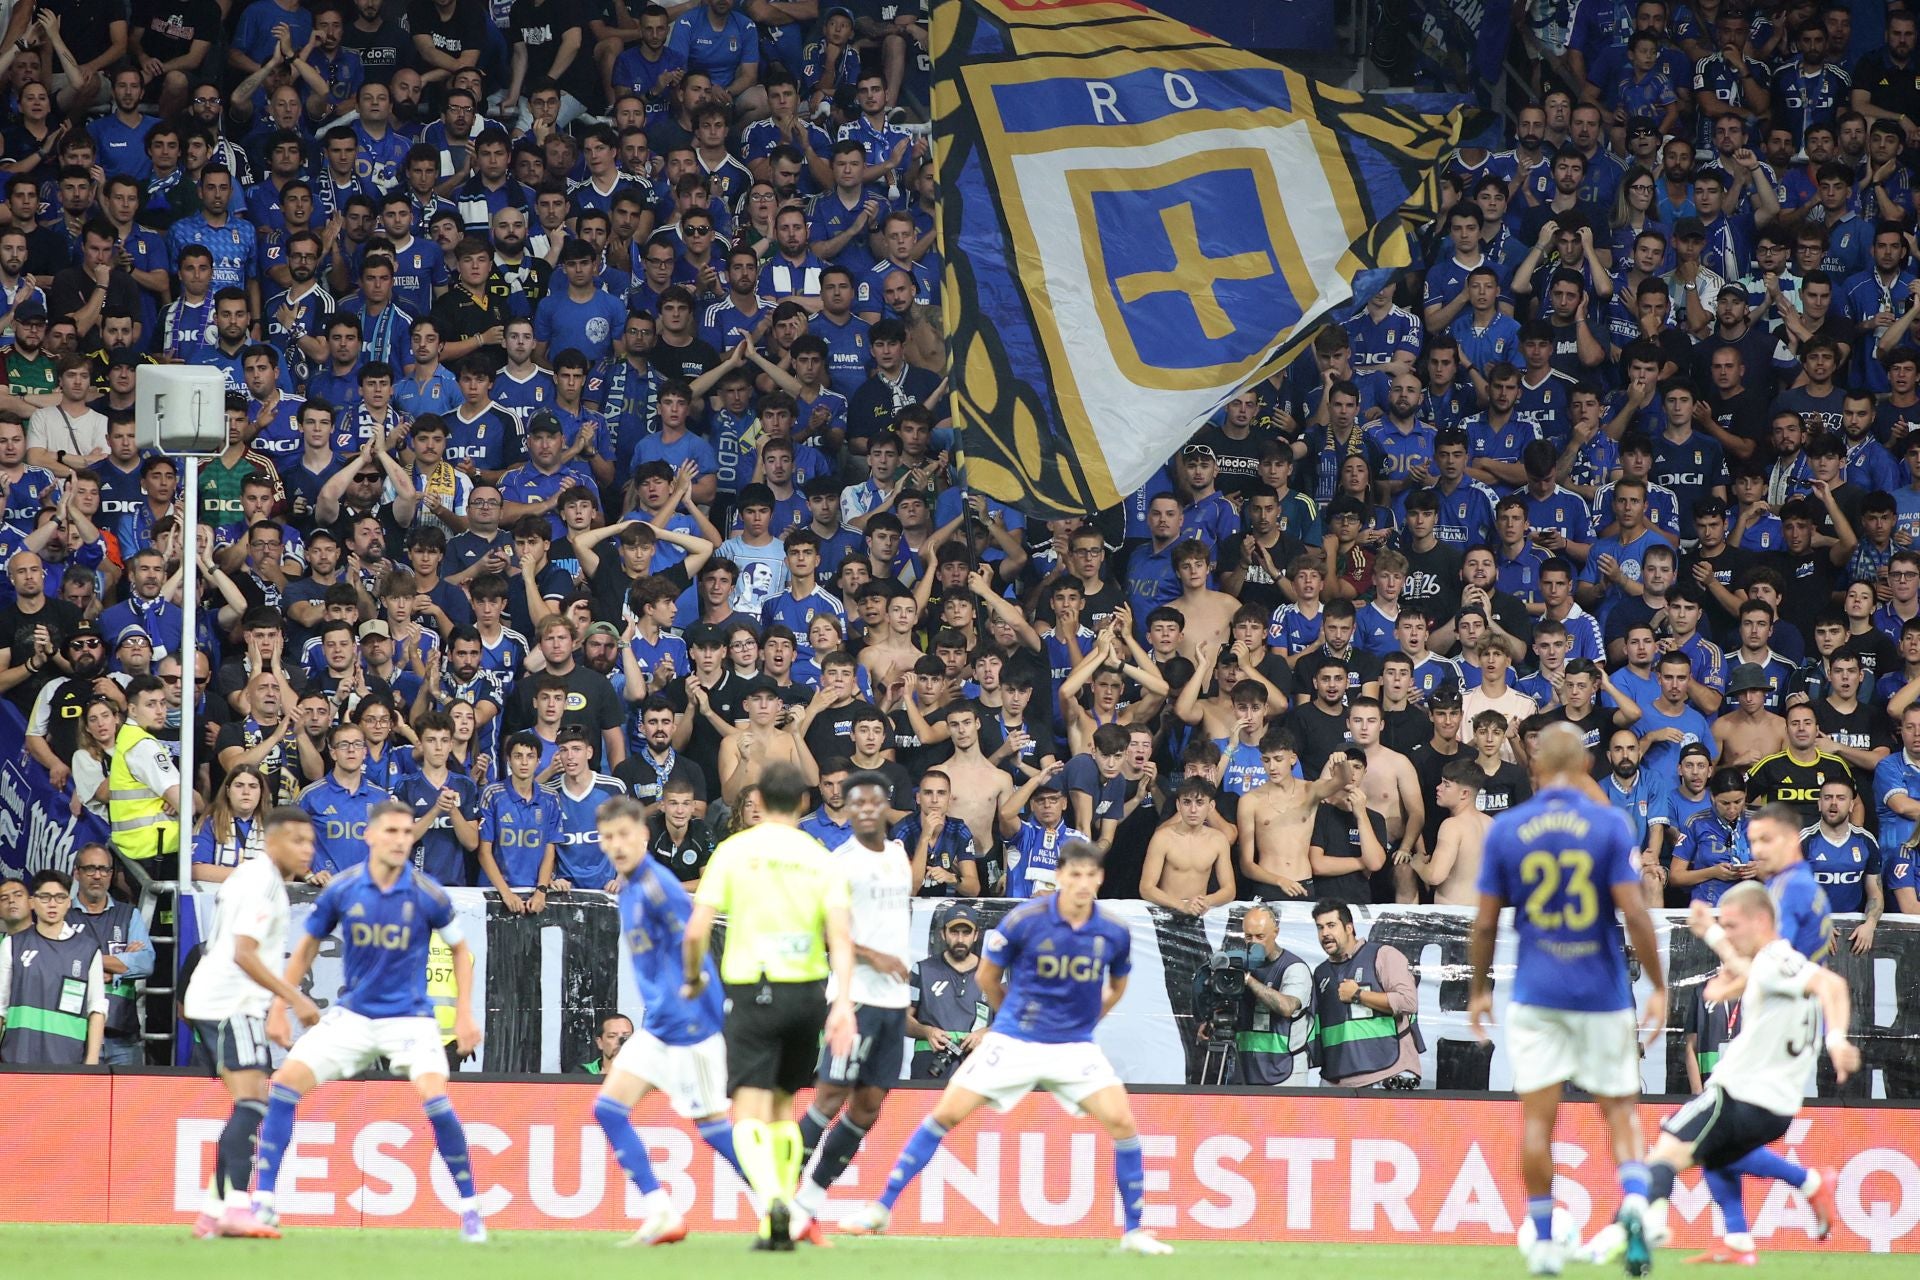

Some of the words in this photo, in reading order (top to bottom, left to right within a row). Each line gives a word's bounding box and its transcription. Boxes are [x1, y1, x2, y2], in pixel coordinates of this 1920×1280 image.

[1086, 82, 1127, 123] R
[1163, 72, 1199, 109] O
[393, 276, 420, 287] NTEGRA
[833, 353, 859, 363] NMR
[9, 383, 50, 395] DIG
[250, 437, 300, 452] DIGI
[446, 446, 486, 460] DIGI
[1216, 457, 1247, 468] viedo
[1386, 455, 1421, 473] DIG
[1658, 472, 1704, 486] DIGI
[102, 500, 144, 513] DIG
[205, 498, 245, 512] DIG
[1432, 531, 1467, 541] TURIANA
[1777, 788, 1821, 801] DIG
[327, 820, 367, 841] DIG
[500, 828, 544, 849] DIGI
[563, 831, 600, 846] DIG
[1038, 849, 1057, 859] REAL
[1813, 870, 1864, 885] DIGI
[1520, 850, 1599, 931] 23
[352, 922, 411, 951] DIGI
[1037, 954, 1102, 983] DIGI
[920, 1131, 1592, 1238] NUESTRAS
